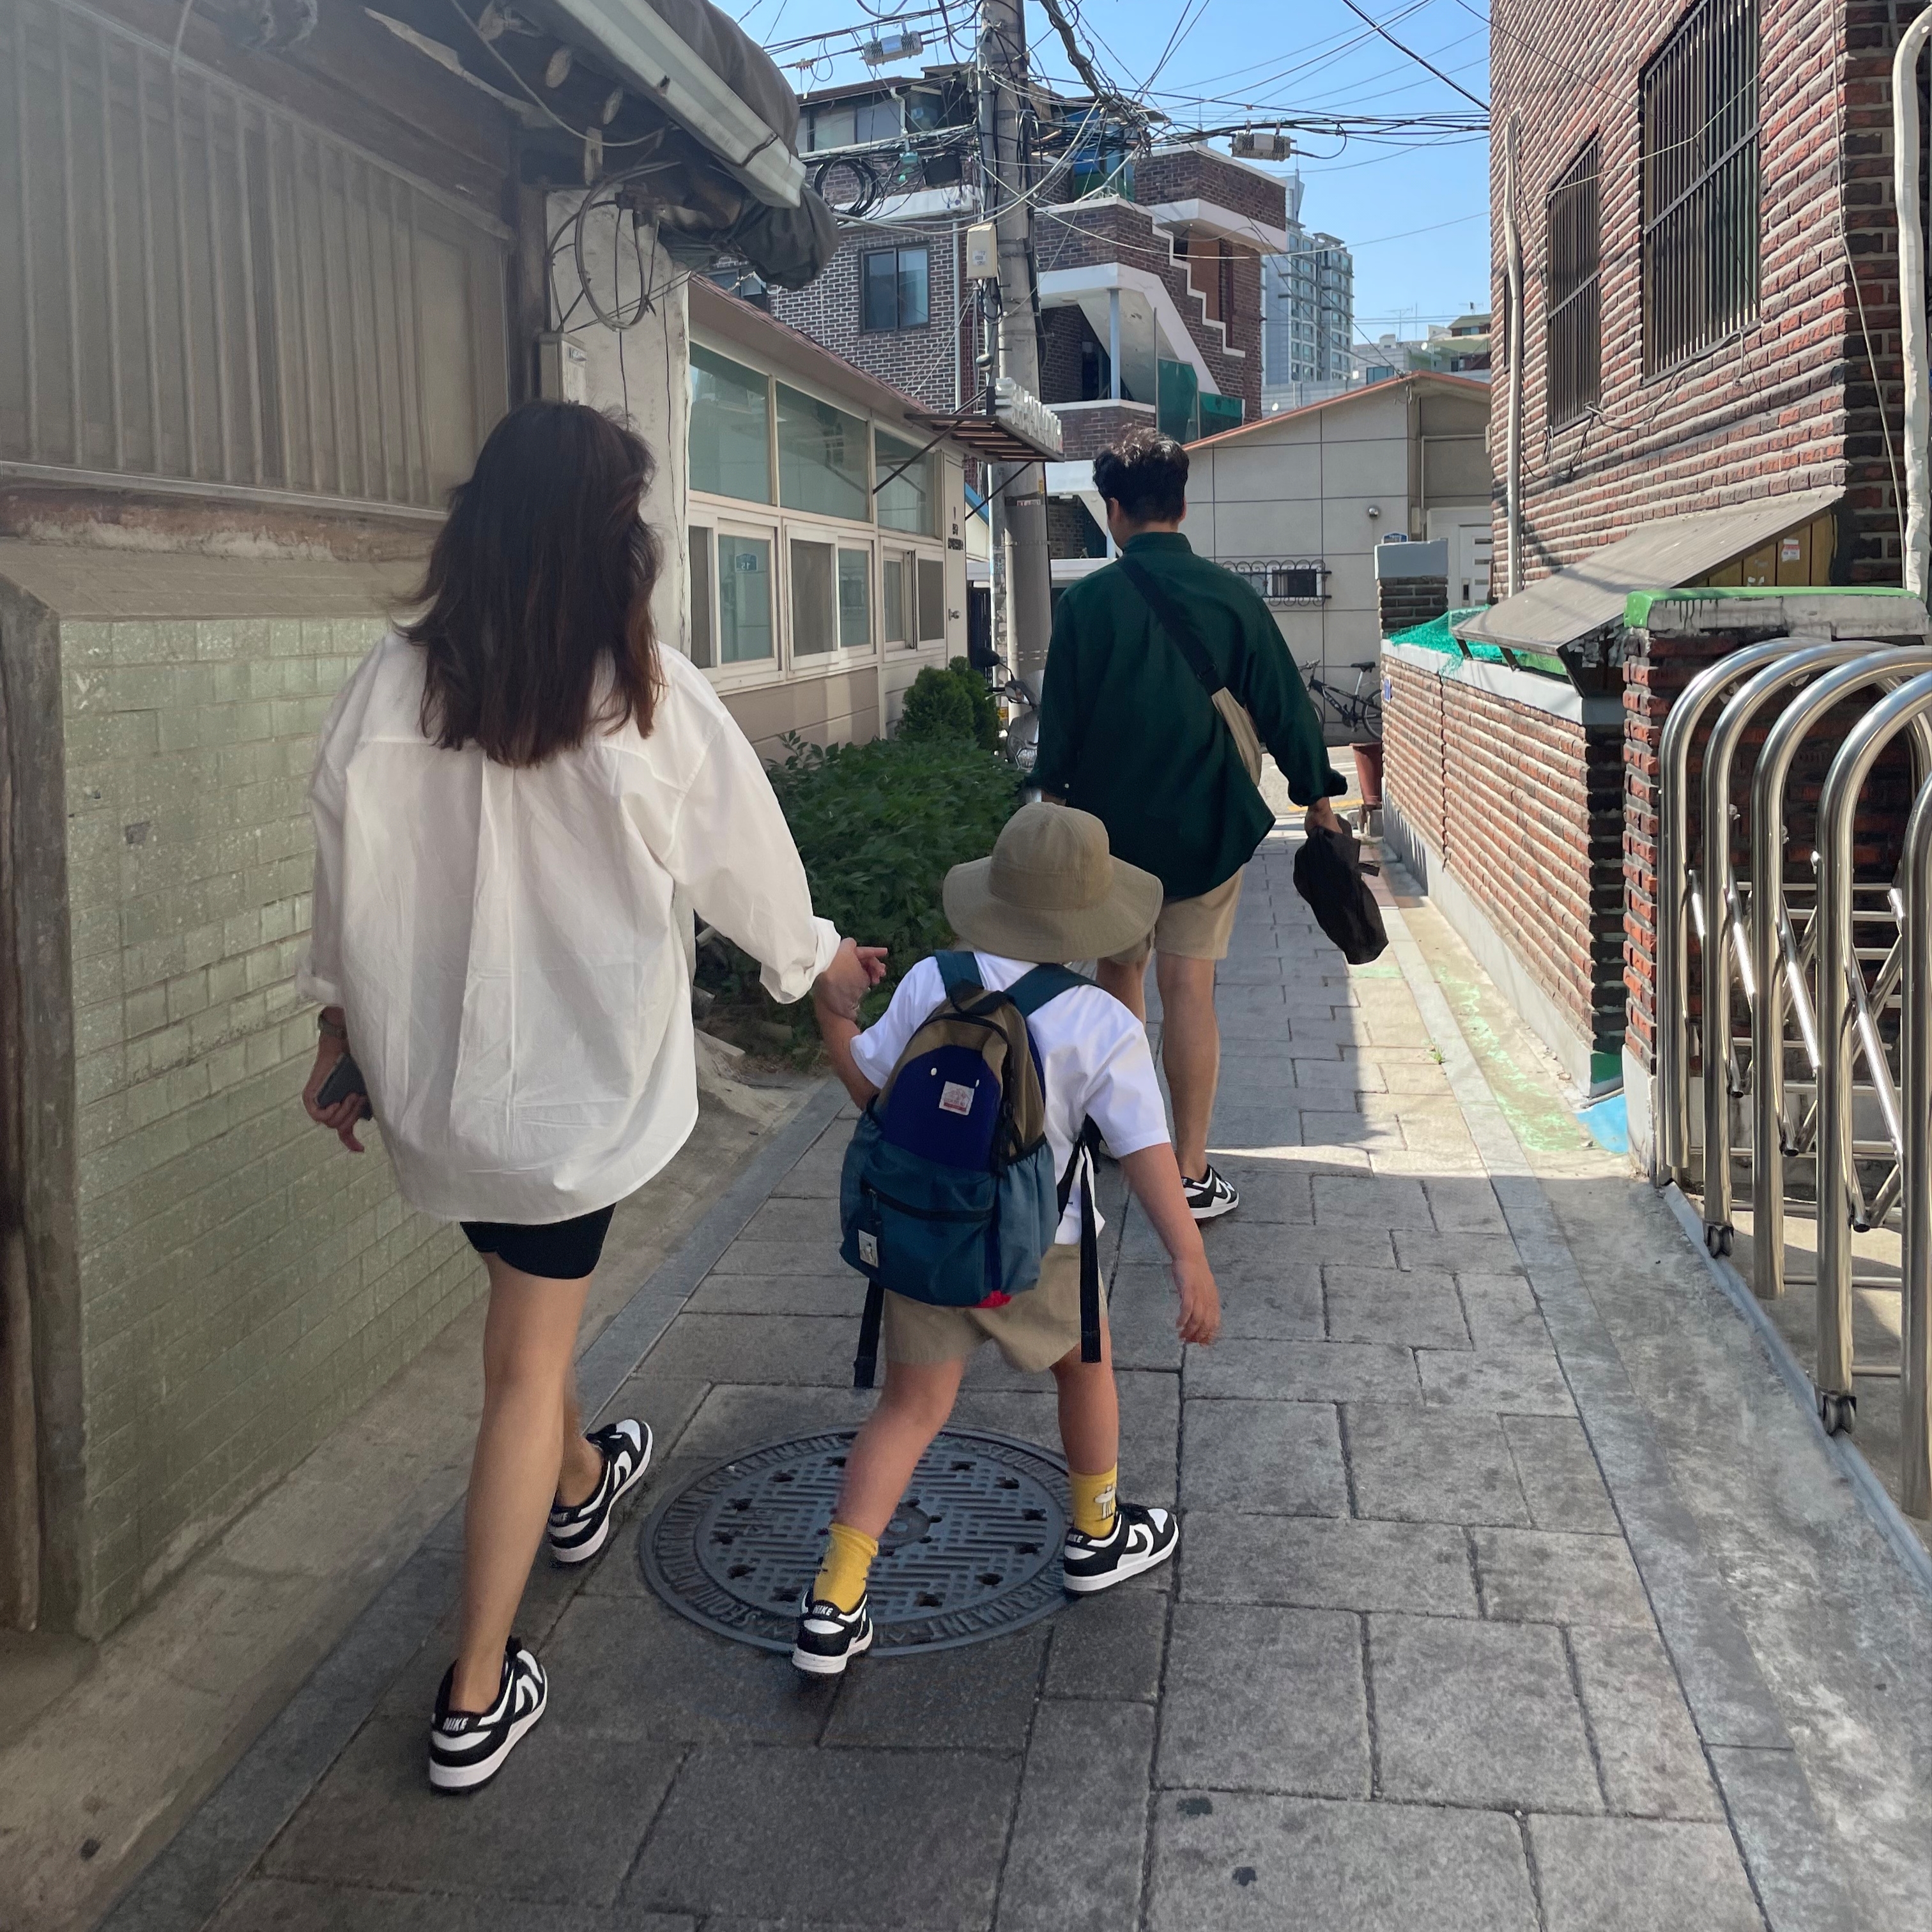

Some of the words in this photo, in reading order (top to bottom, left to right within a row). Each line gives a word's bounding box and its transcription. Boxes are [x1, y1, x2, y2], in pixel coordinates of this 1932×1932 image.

[685, 1584, 761, 1627] SEOUL
[813, 1605, 833, 1616] NIKE
[443, 1717, 469, 1731] NIKE
